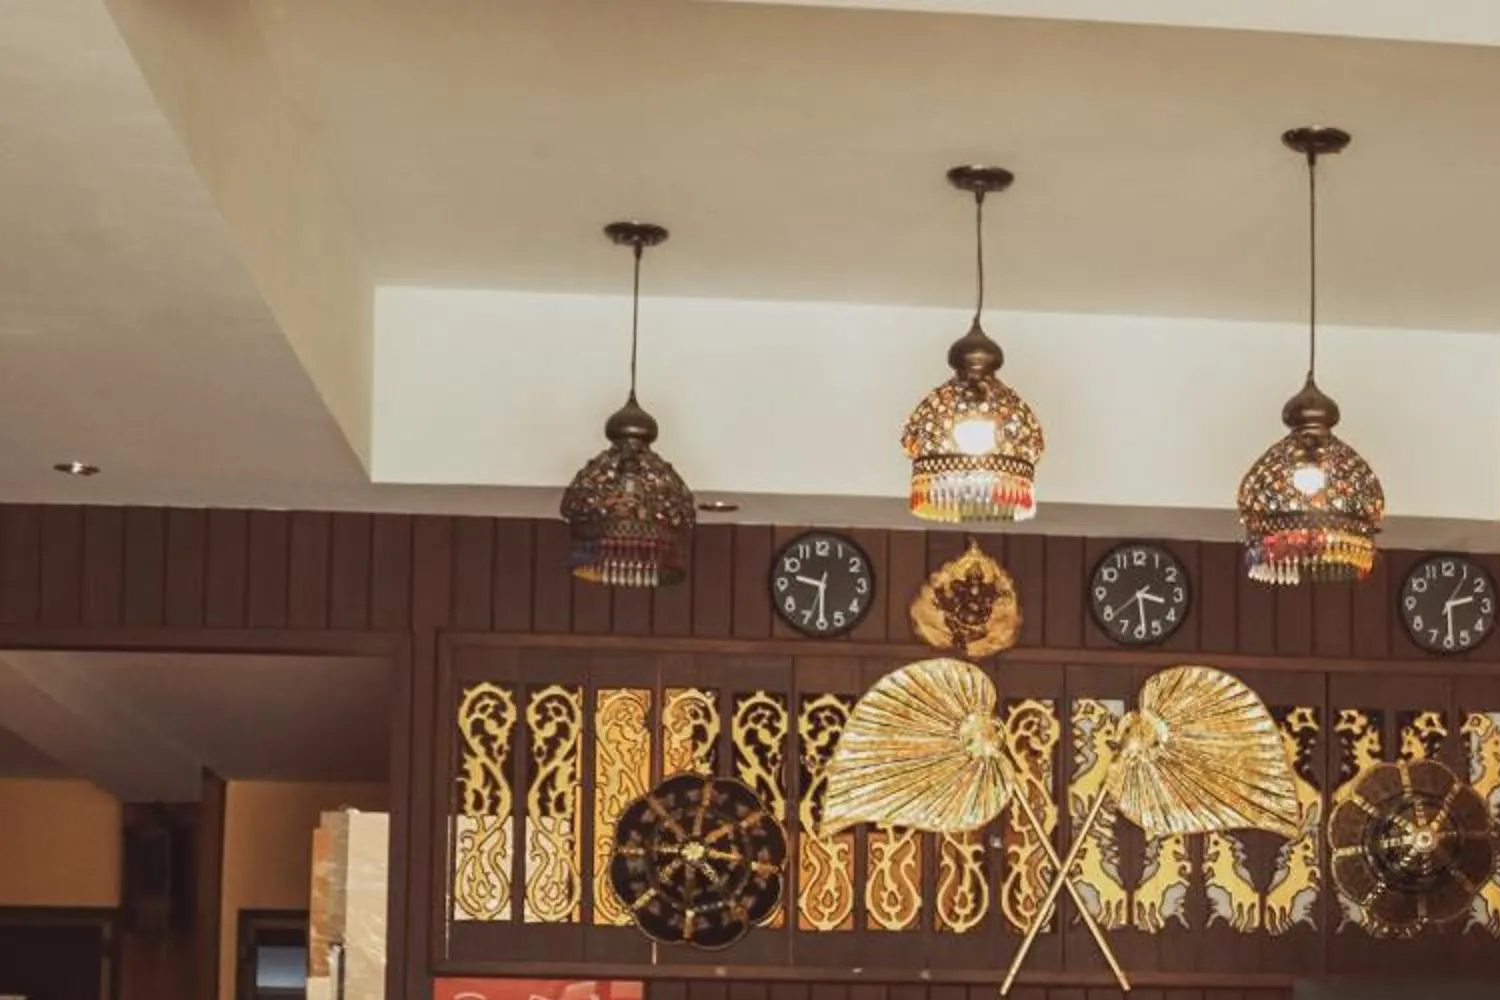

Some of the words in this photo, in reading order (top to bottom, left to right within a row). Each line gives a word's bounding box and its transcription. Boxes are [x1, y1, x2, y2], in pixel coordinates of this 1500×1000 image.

[799, 543, 810, 559] 11
[815, 541, 829, 556] 12
[784, 557, 800, 573] 10
[848, 557, 860, 573] 2
[1116, 554, 1127, 569] 11
[1133, 550, 1146, 566] 12
[1102, 567, 1118, 583] 10
[1165, 567, 1177, 582] 2
[1425, 565, 1437, 579] 11
[1441, 561, 1455, 577] 12
[776, 577, 789, 592] 9
[856, 577, 867, 593] 3
[1411, 577, 1427, 593] 10
[1473, 577, 1485, 593] 2
[1095, 586, 1106, 601] 9
[1173, 587, 1183, 603] 3
[784, 595, 796, 612] 8
[848, 598, 859, 613] 4
[1405, 595, 1417, 611] 9
[1481, 597, 1491, 613] 3
[801, 609, 812, 625] 7
[833, 611, 844, 627] 5
[1103, 605, 1114, 621] 8
[1165, 607, 1176, 622] 4
[1119, 619, 1129, 634] 7
[1151, 620, 1162, 636] 5
[1413, 615, 1423, 631] 8
[1474, 618, 1484, 632] 4
[1428, 628, 1438, 643] 7
[1459, 630, 1471, 646] 5
